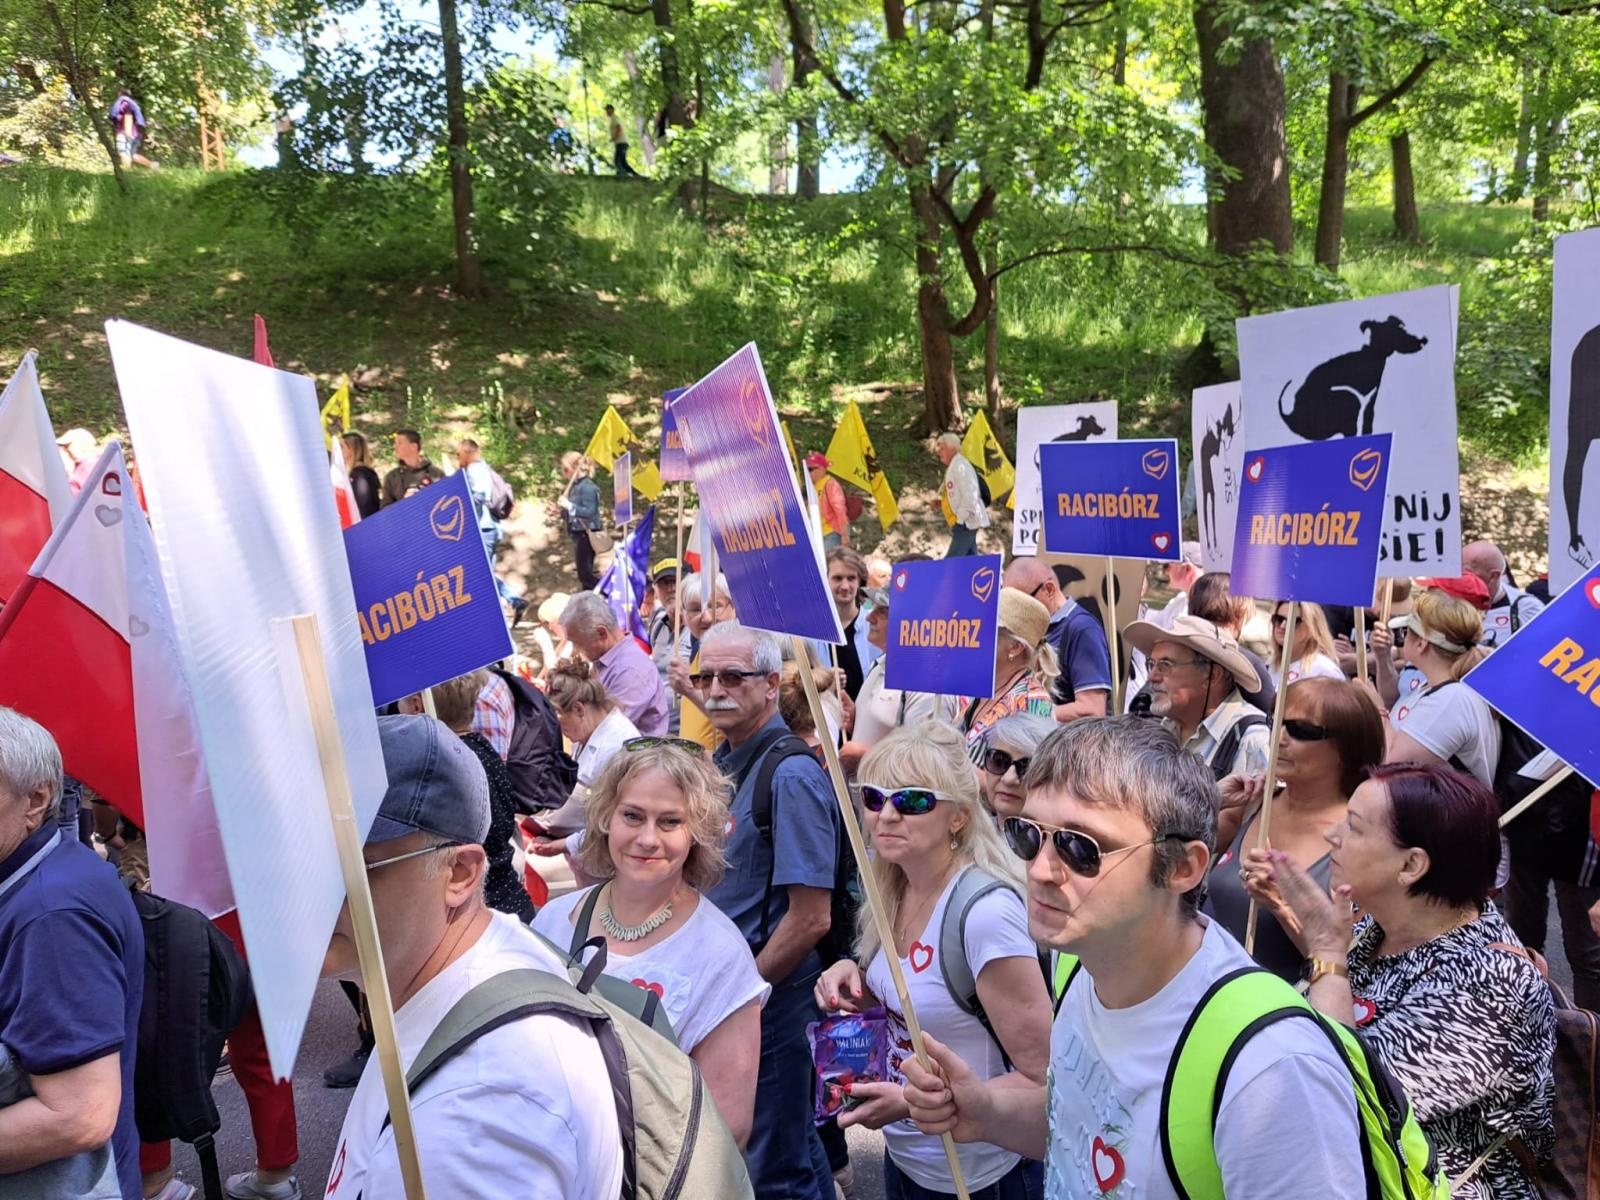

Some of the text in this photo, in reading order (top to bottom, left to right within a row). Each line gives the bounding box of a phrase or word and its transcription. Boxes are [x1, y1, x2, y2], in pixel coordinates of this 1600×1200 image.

[1057, 486, 1160, 518] RACIBÓRZ
[1249, 502, 1361, 546] RACIBÓRZ
[899, 610, 981, 648] RACIBÓRZ
